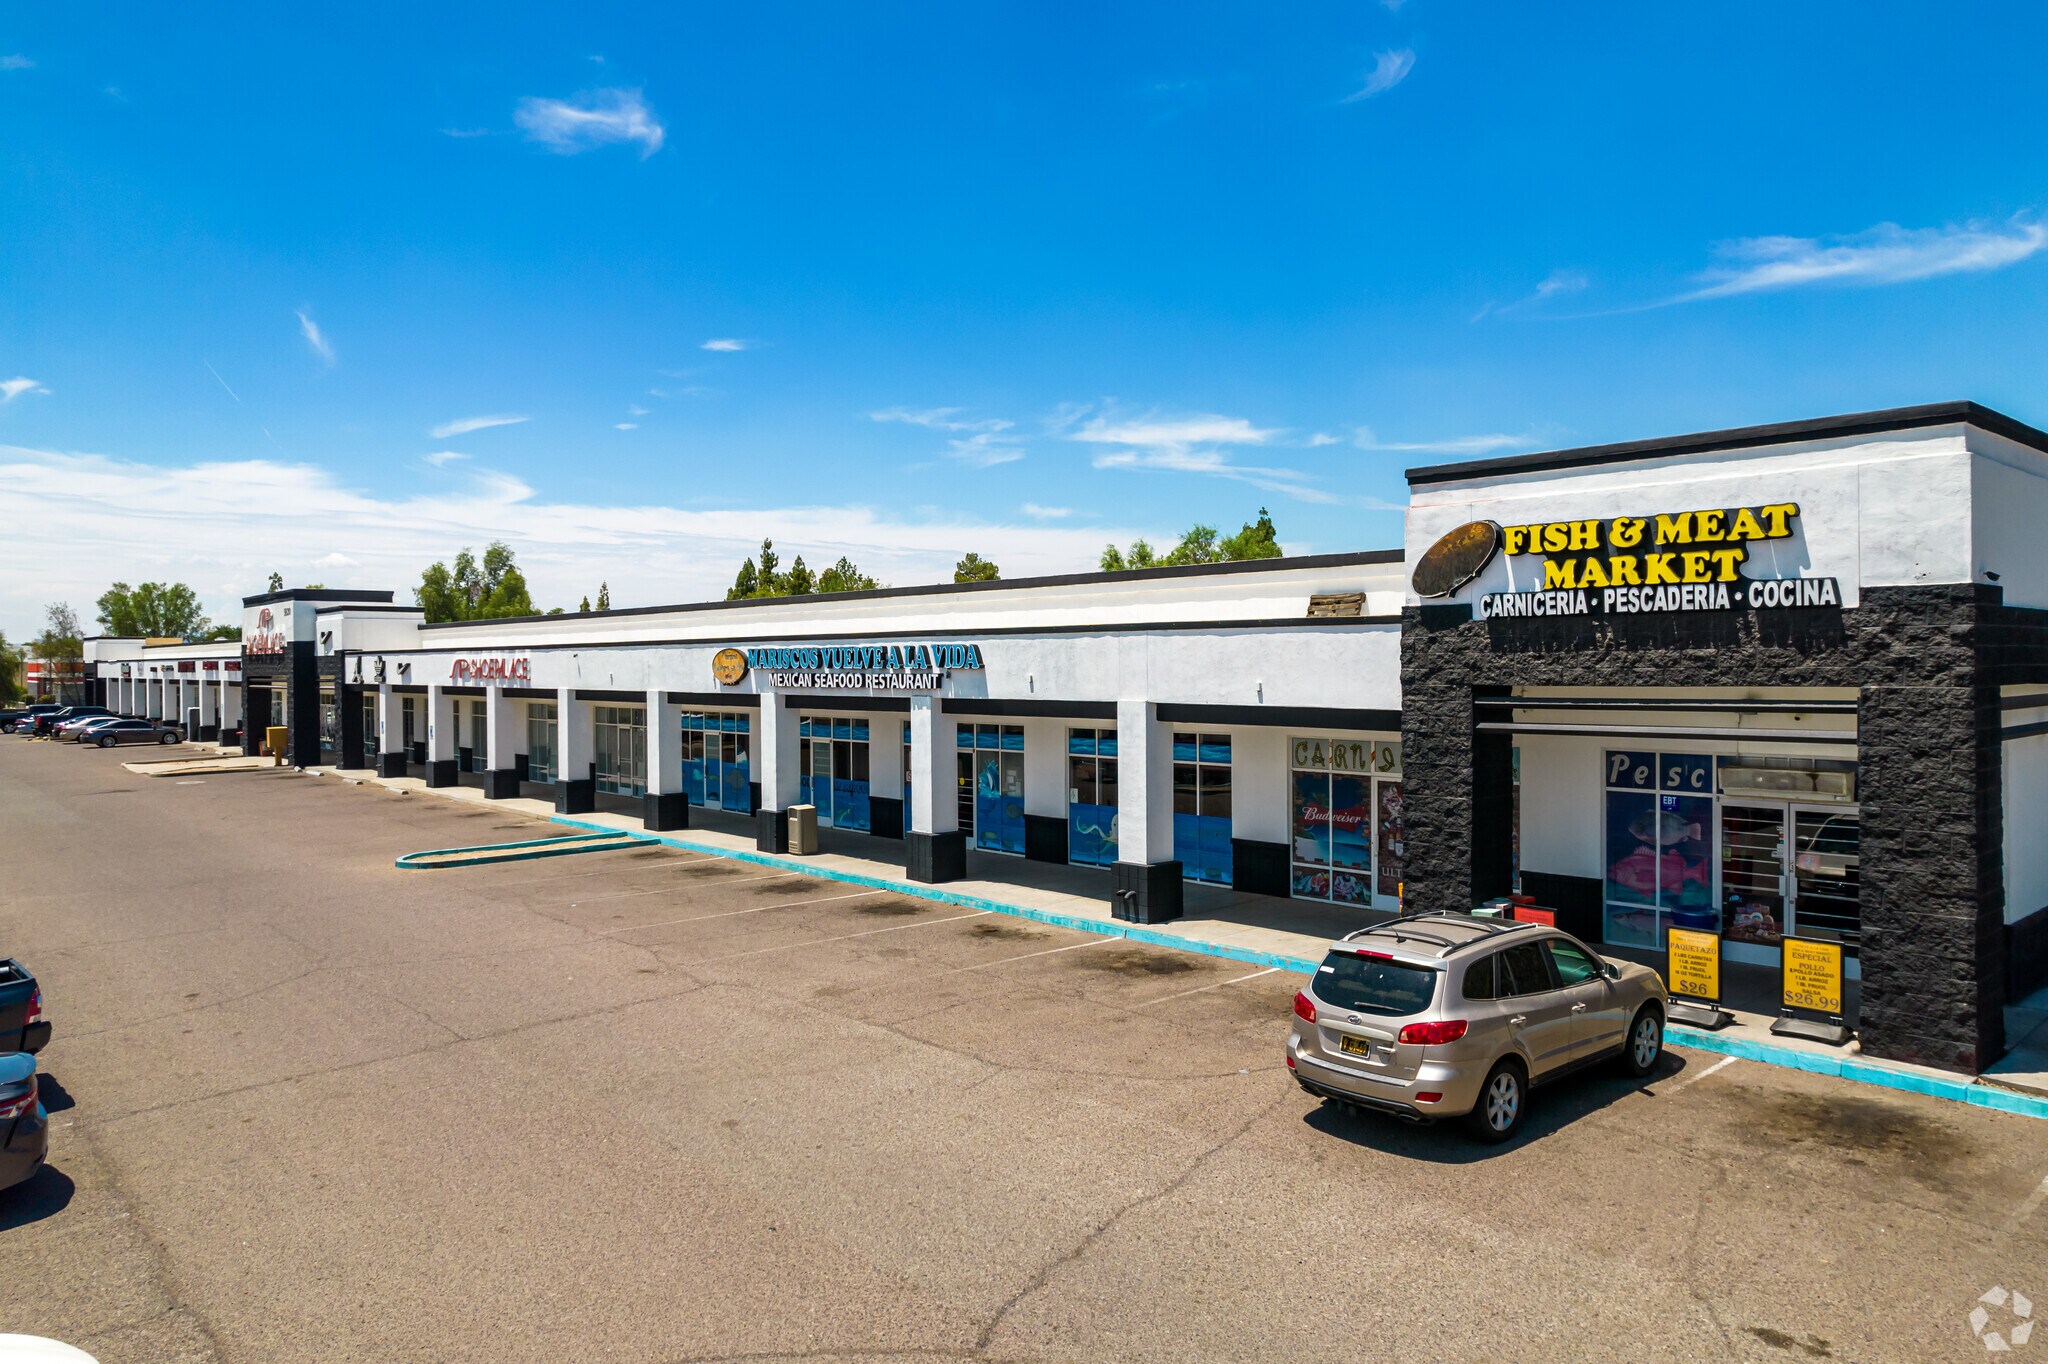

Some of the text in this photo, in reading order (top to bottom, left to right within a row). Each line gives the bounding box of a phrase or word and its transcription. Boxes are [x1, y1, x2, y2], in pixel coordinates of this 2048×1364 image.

[1504, 519, 1600, 554] FISH
[1609, 516, 1646, 548] &
[1655, 503, 1797, 545] MEAT
[1544, 548, 1744, 589] MARKET
[1480, 578, 1836, 619] CARNICERIA PESCADERIA COCINA
[747, 648, 817, 670] MARISCOS
[820, 646, 884, 669] VUELVE
[886, 646, 902, 669] A
[904, 645, 927, 669] LA
[931, 644, 980, 669] VIDA
[768, 672, 939, 690] MEXICAN SEAFOOD RESTAURANT
[1295, 740, 1404, 772] CARNI
[1663, 795, 1677, 805] EBT
[1302, 806, 1361, 823] Budweiser
[1670, 942, 1717, 954] PAQUETAZO
[1792, 952, 1832, 963] ESPECIAL
[1799, 963, 1825, 972] POLLO
[1680, 979, 1707, 995] $26
[1785, 990, 1839, 1010] $26.99
